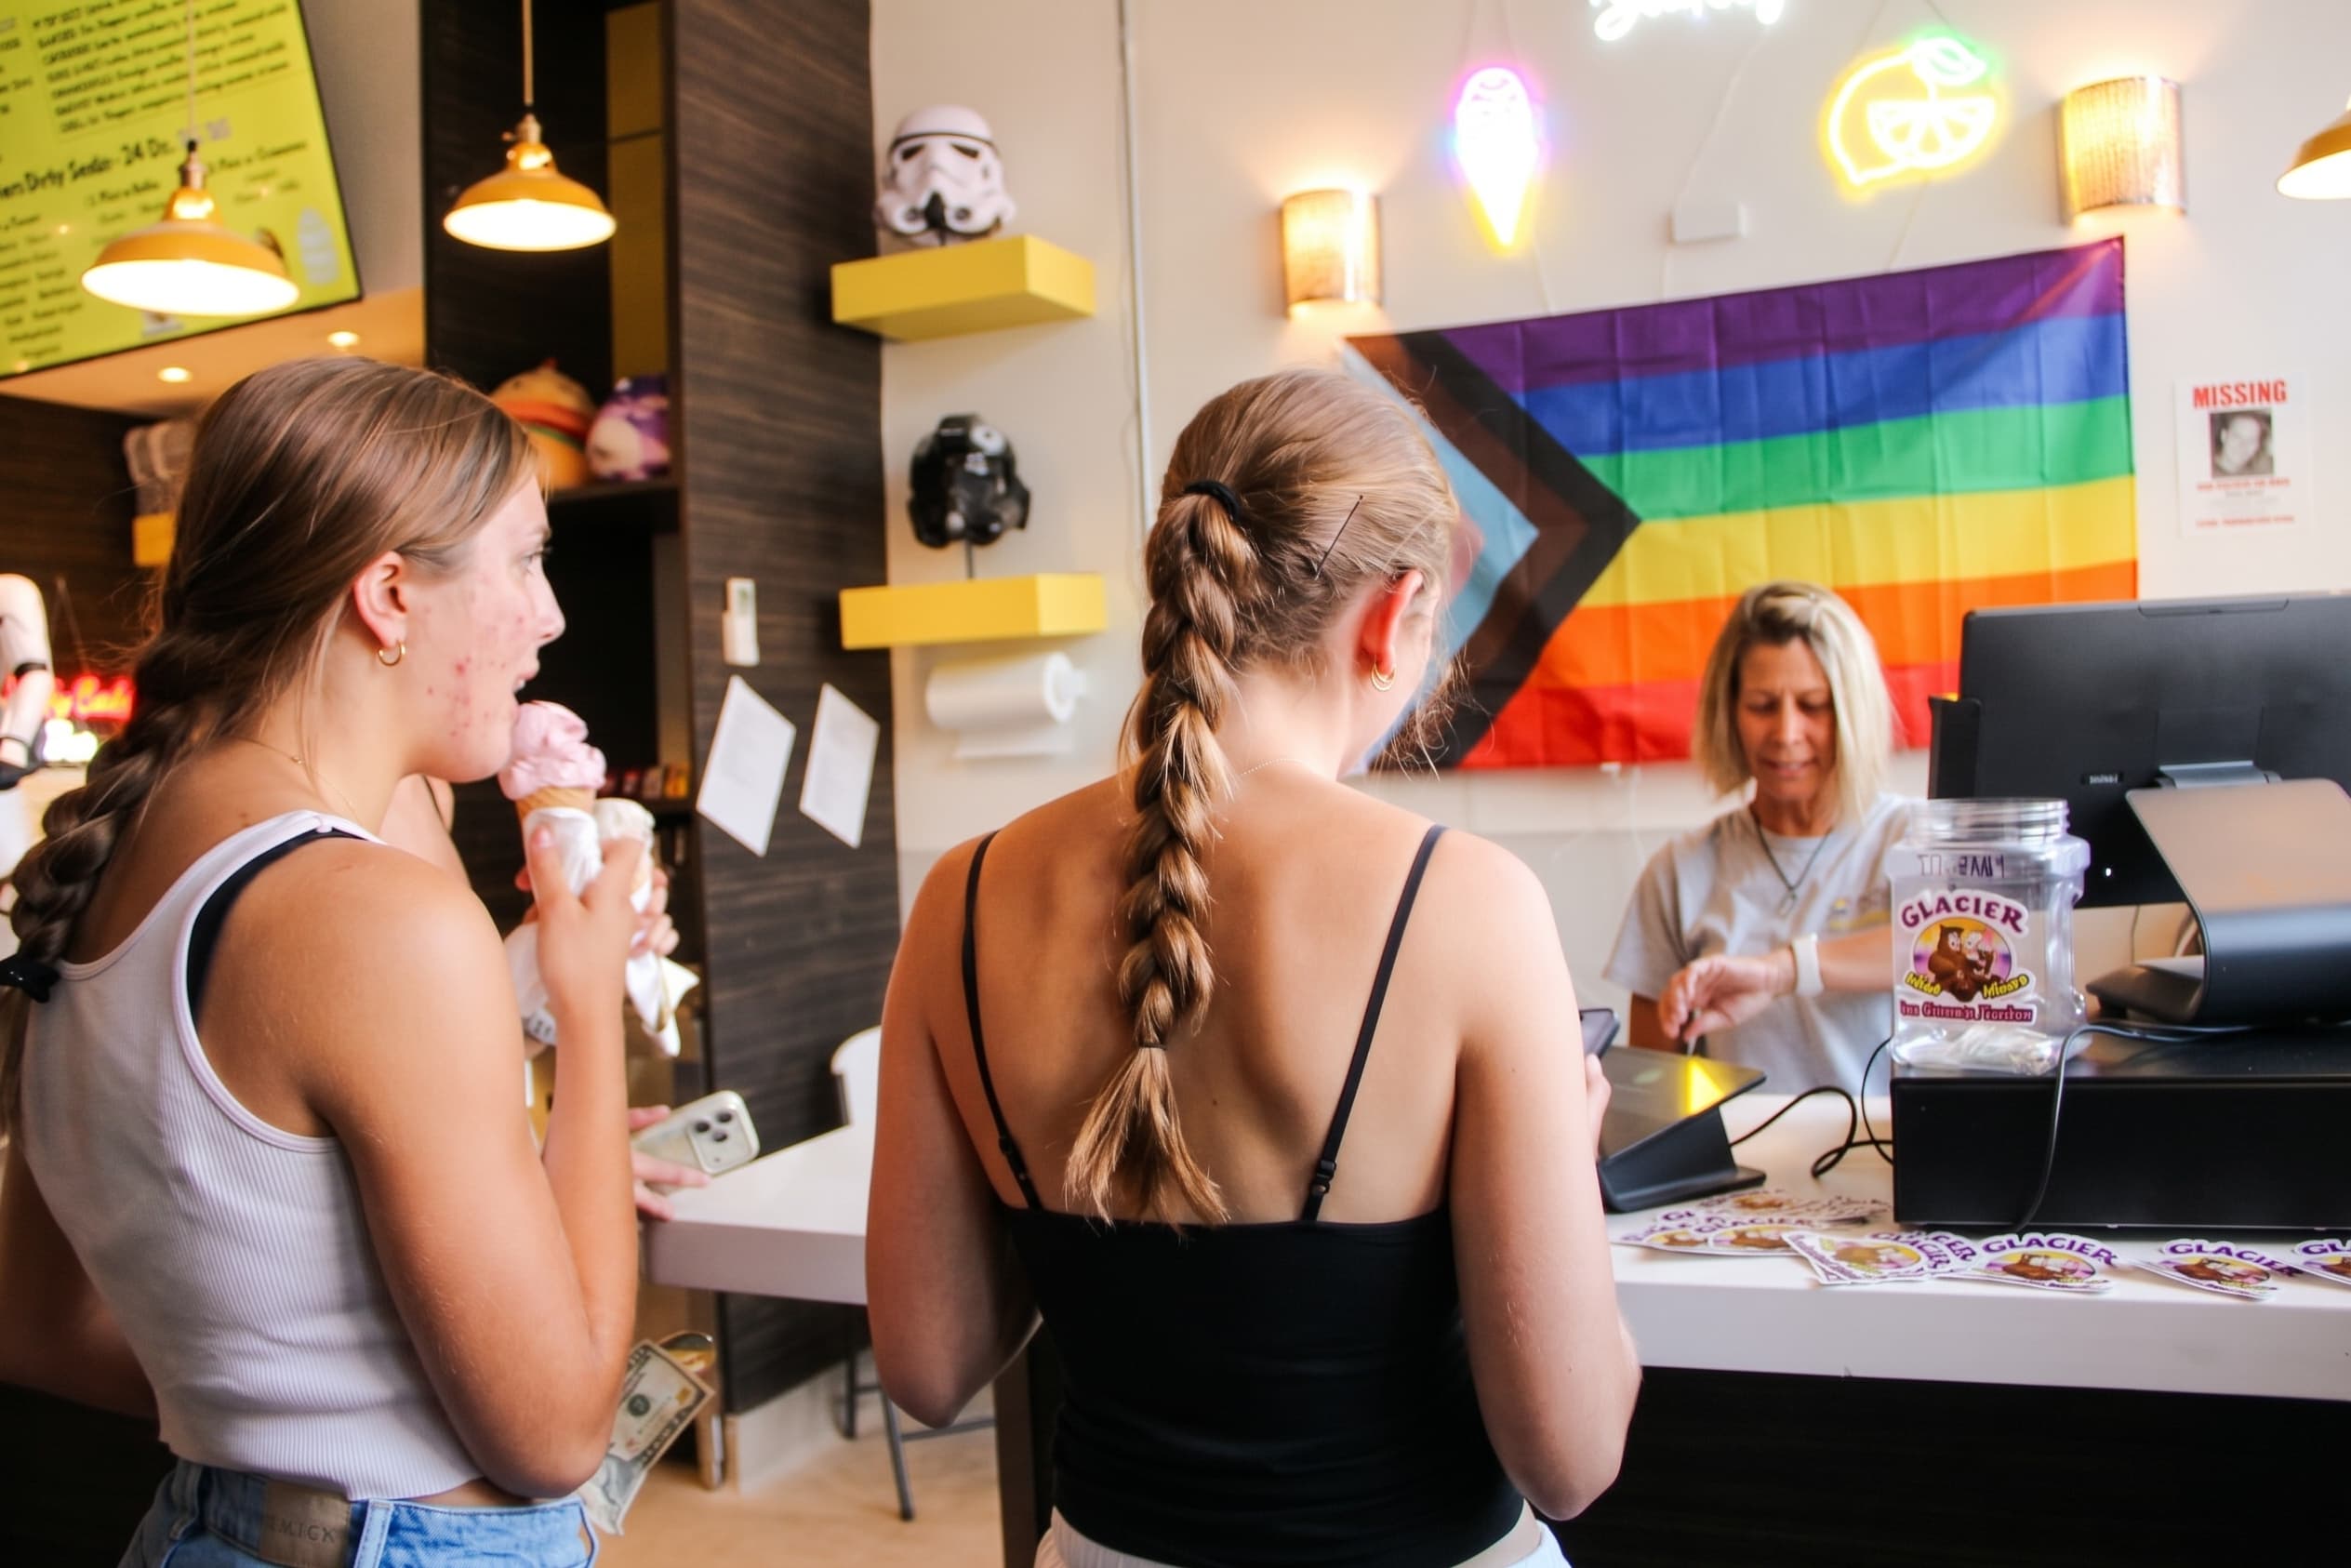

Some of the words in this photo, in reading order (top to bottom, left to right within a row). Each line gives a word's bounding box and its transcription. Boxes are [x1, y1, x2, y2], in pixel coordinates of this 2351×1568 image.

[2193, 379, 2288, 408] MISSING
[1901, 896, 2024, 934] GLACIER
[1982, 1237, 2119, 1269] GLACIER
[2168, 1242, 2305, 1278] GLACIER
